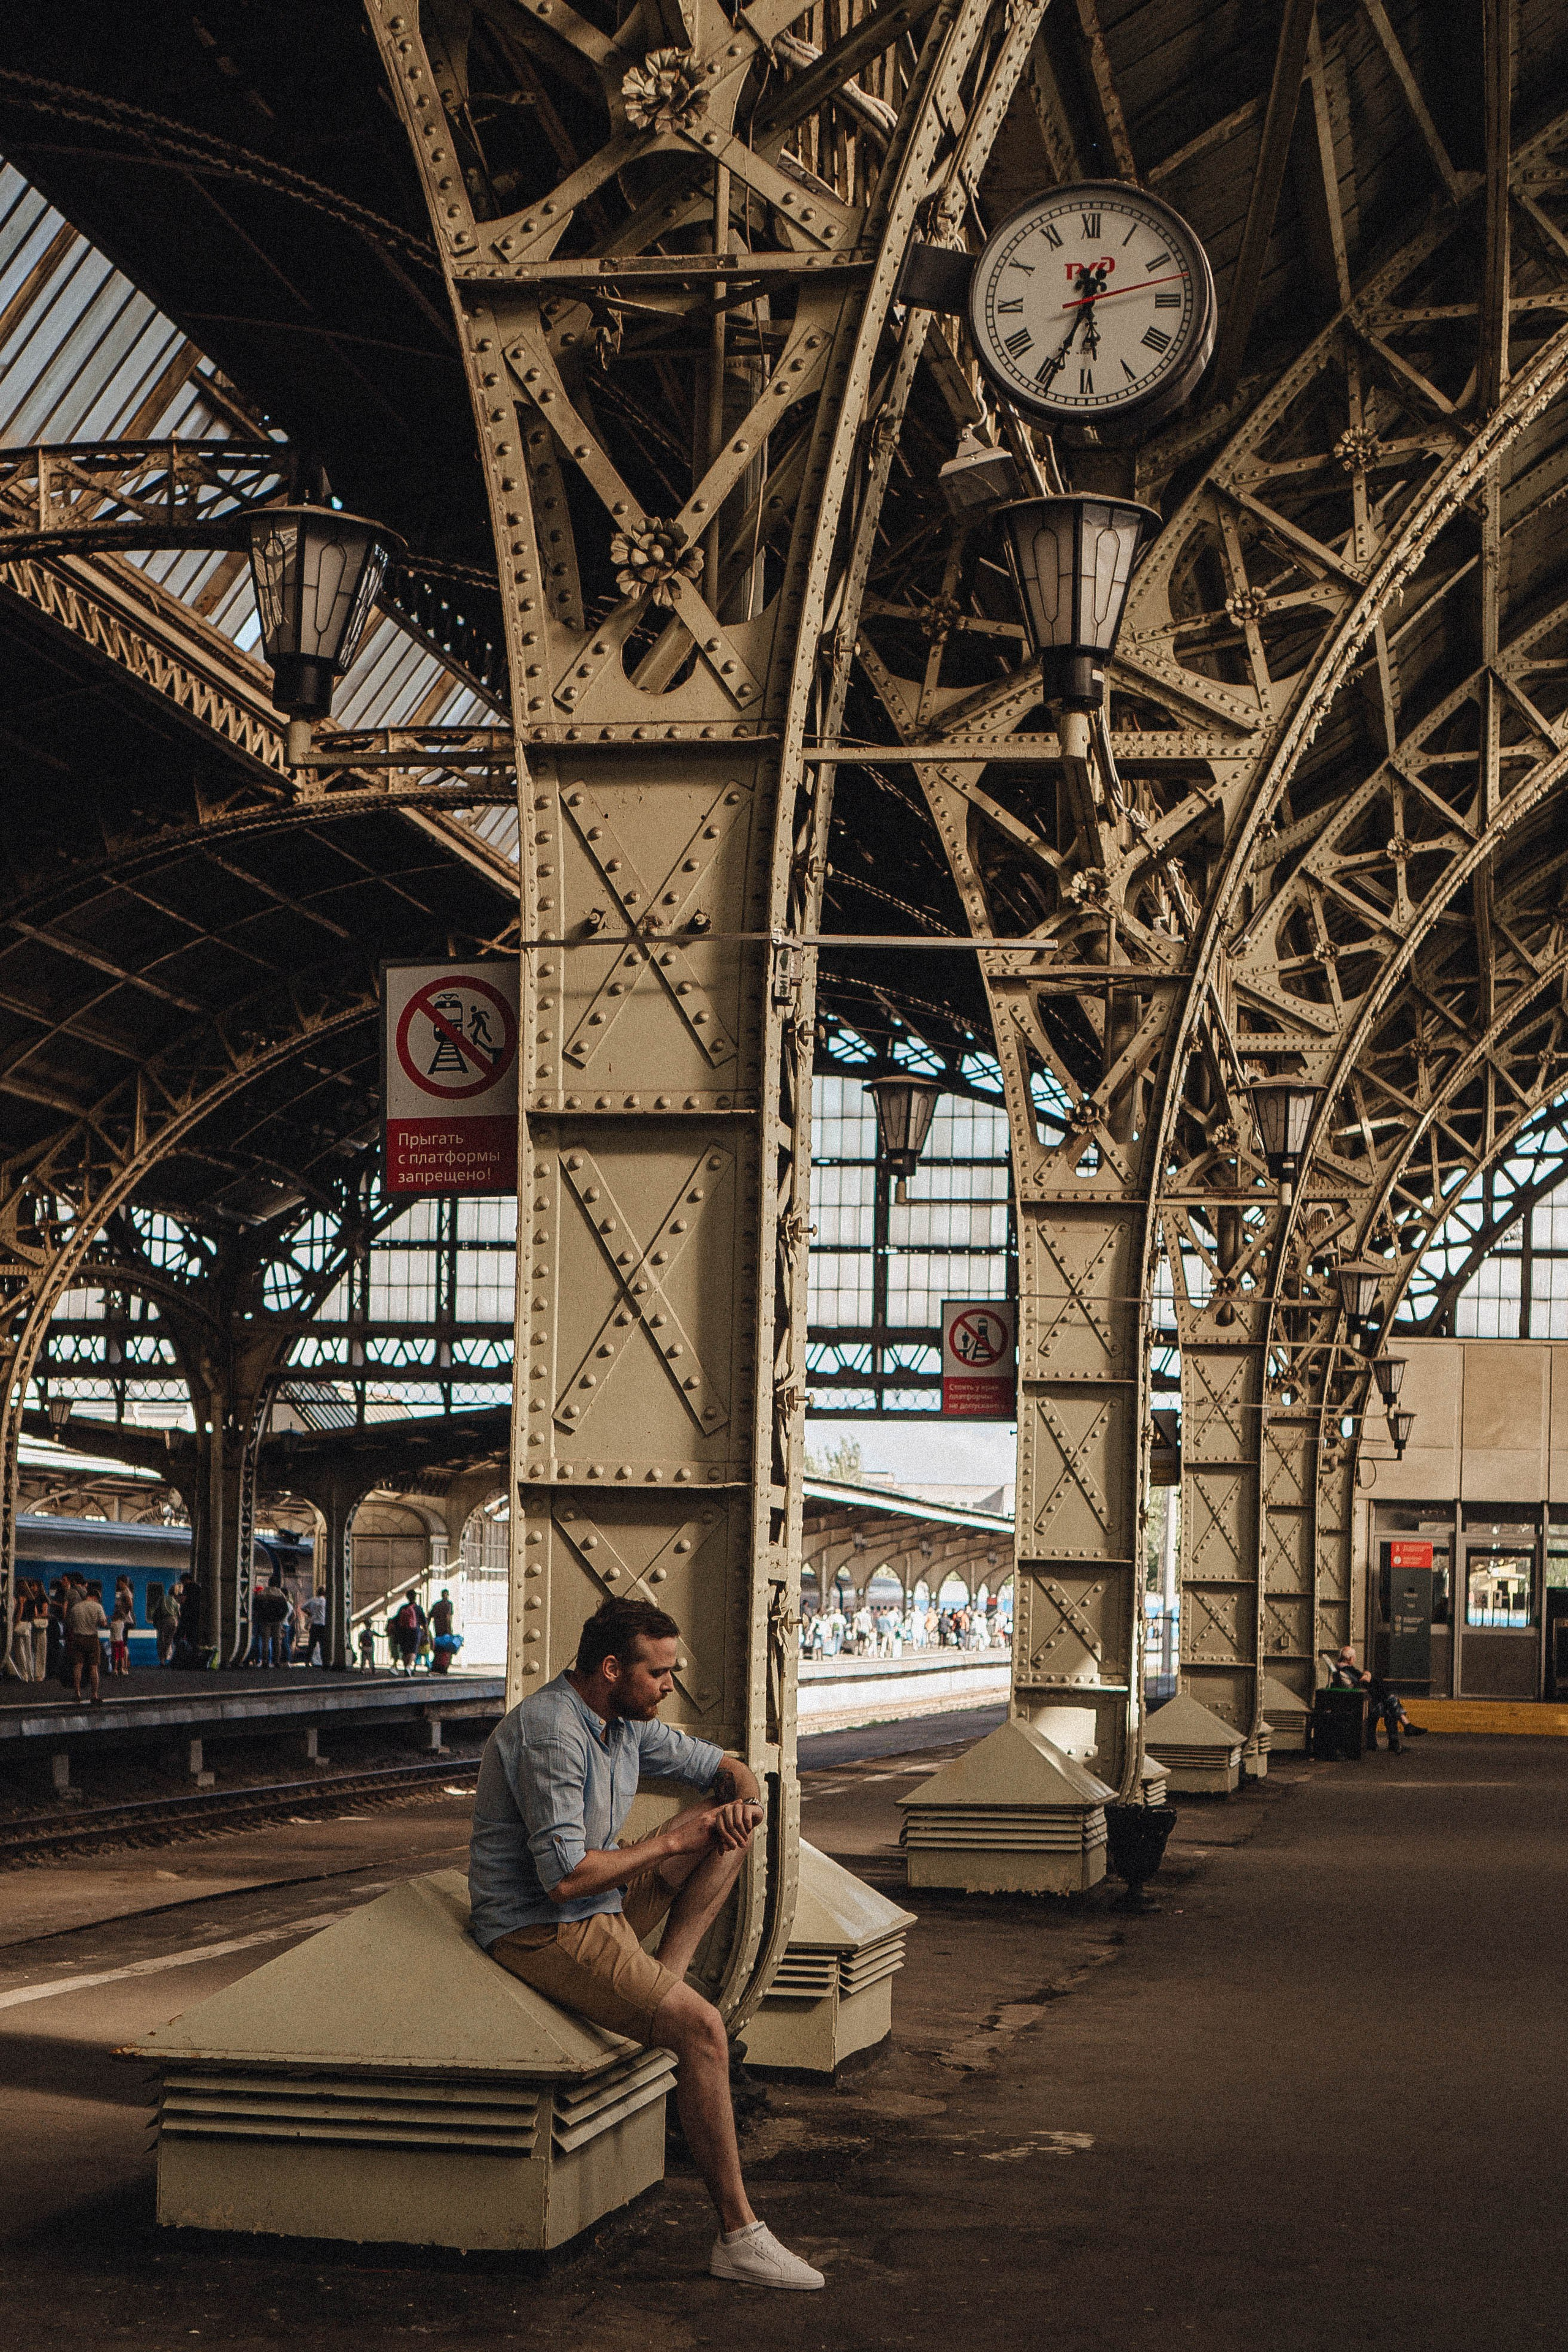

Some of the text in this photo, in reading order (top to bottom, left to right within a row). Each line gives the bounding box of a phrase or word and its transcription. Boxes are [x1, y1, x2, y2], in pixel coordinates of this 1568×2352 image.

[1081, 213, 1101, 239] XII
[1122, 223, 1137, 247] I
[1041, 224, 1063, 251] XI
[1009, 257, 1035, 277] X
[1145, 252, 1172, 273] II
[998, 298, 1023, 314] IX
[1155, 293, 1181, 309] III
[1005, 327, 1035, 360] VIII
[1120, 358, 1136, 382] V
[1080, 368, 1094, 394] VI
[399, 1133, 464, 1149] Прыгать
[398, 1150, 500, 1166] с платформы
[398, 1167, 491, 1186] запрещено!
